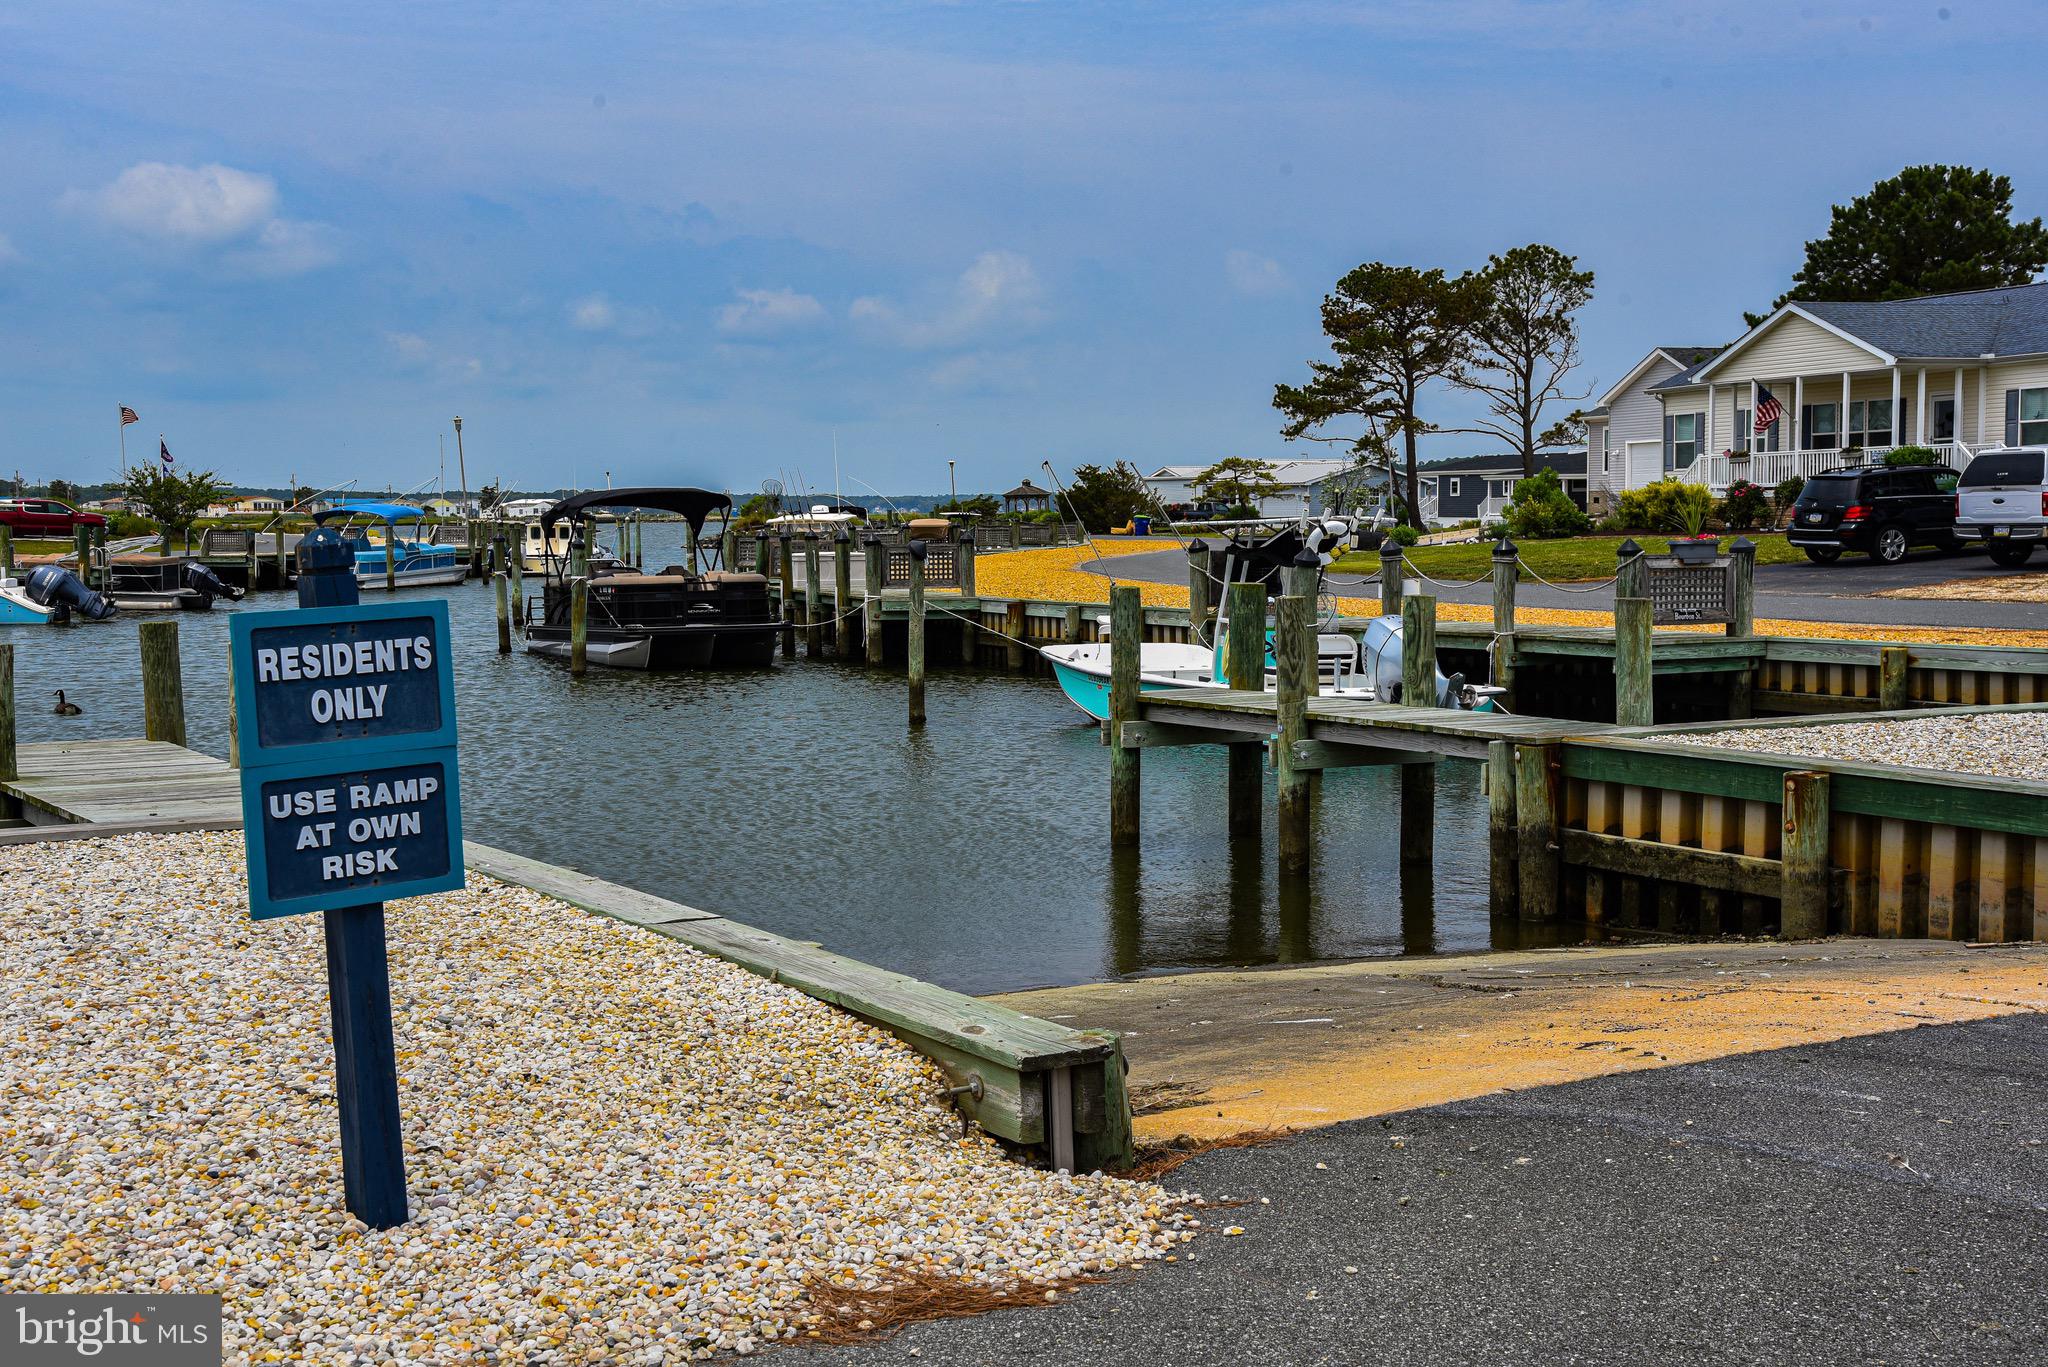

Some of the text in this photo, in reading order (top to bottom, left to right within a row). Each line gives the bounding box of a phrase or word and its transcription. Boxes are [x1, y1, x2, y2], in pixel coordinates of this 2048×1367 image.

[257, 636, 432, 682] RESIDENTS
[311, 684, 387, 723] ONLY
[269, 777, 438, 819] USE RAMP
[296, 811, 421, 851] AT OWN
[322, 847, 398, 881] RISK
